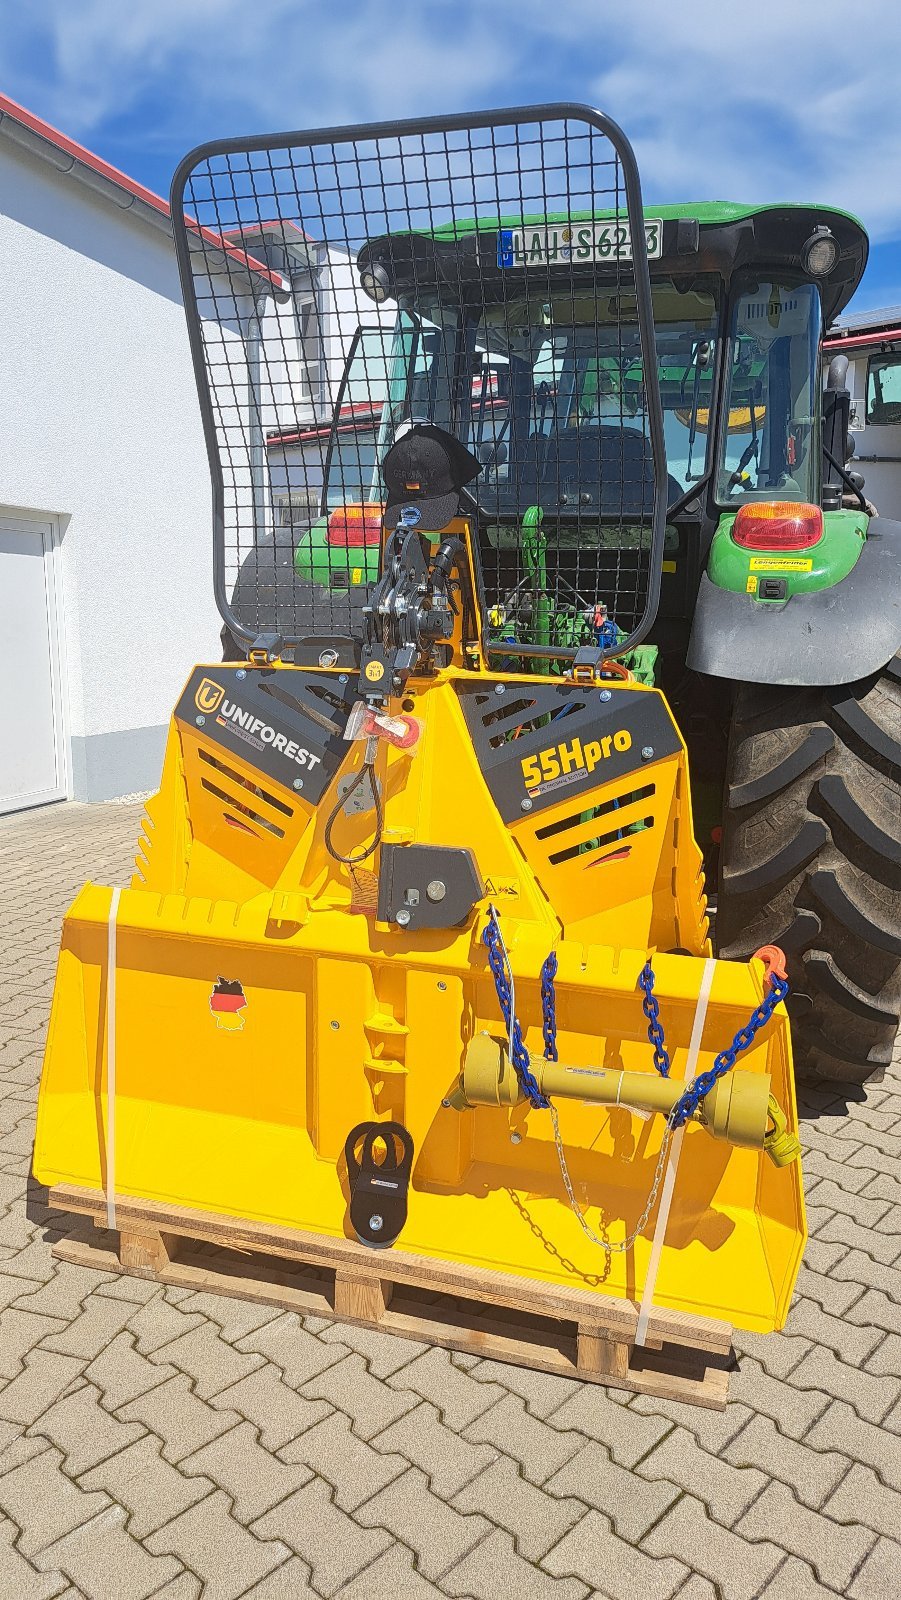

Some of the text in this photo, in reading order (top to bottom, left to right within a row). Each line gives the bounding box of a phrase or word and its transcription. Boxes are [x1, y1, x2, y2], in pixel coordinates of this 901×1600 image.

[514, 225, 659, 262] LAU S 623
[221, 700, 321, 771] UNIFOREST
[521, 730, 632, 788] 55Hpro
